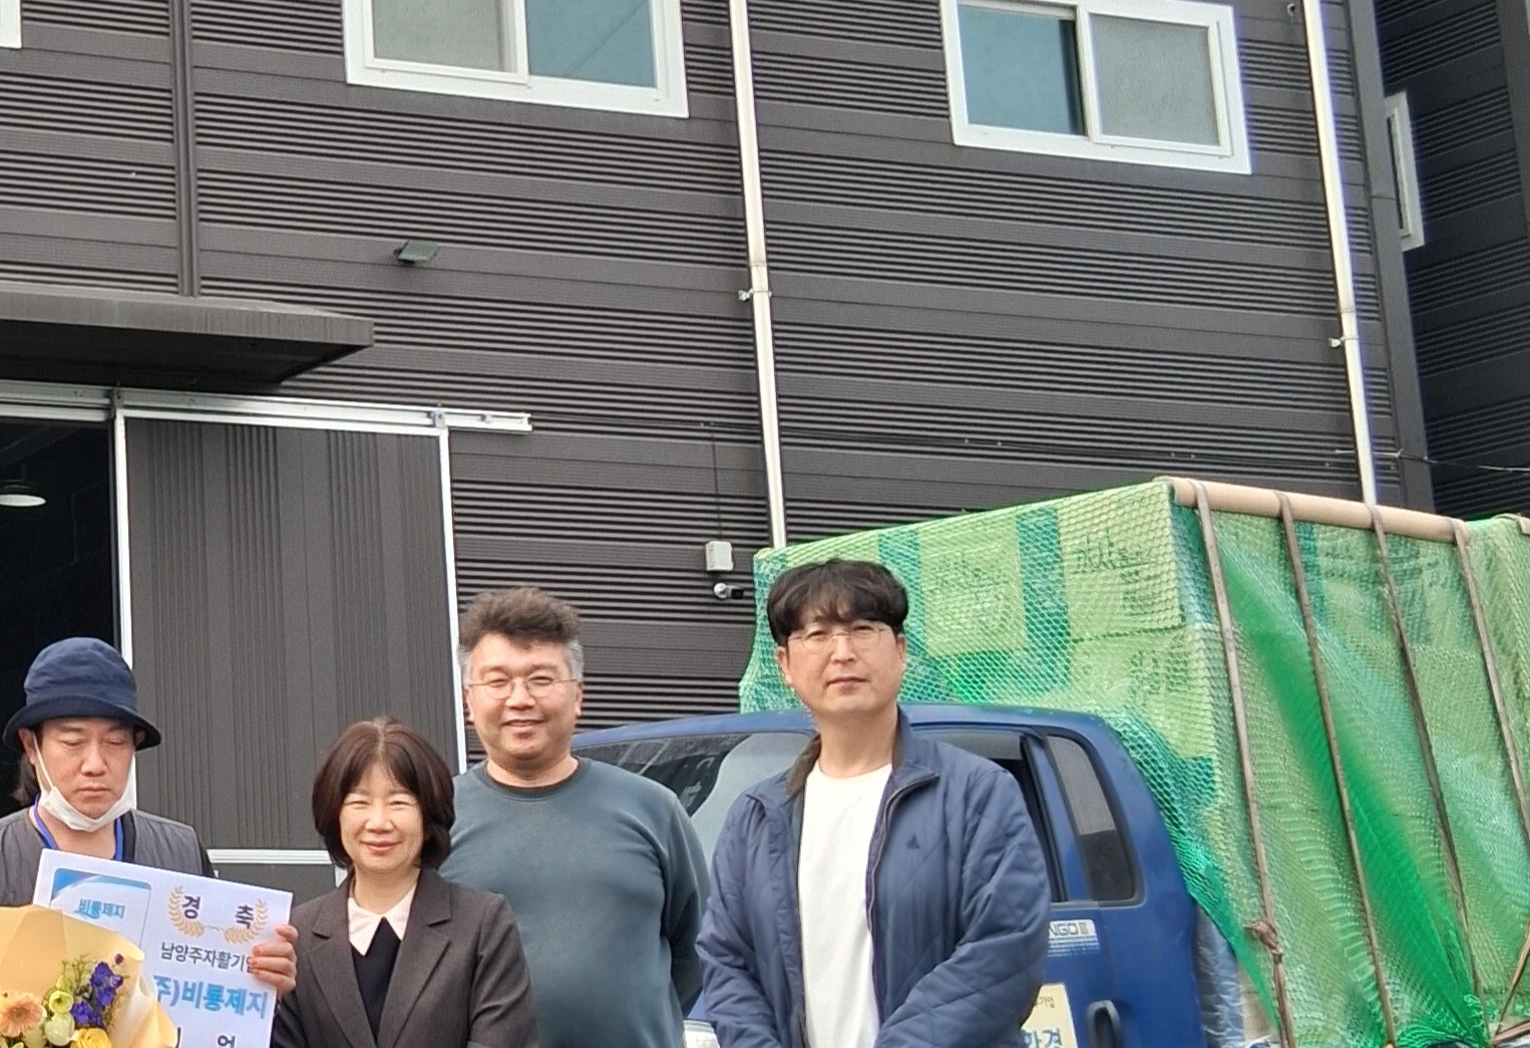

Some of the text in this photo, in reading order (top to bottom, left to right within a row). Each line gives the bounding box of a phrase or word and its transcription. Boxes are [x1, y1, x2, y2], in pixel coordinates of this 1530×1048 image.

[78, 897, 125, 920] 비룡제지
[181, 895, 255, 929] 경 축
[152, 974, 269, 1019] 주)비룡제지
